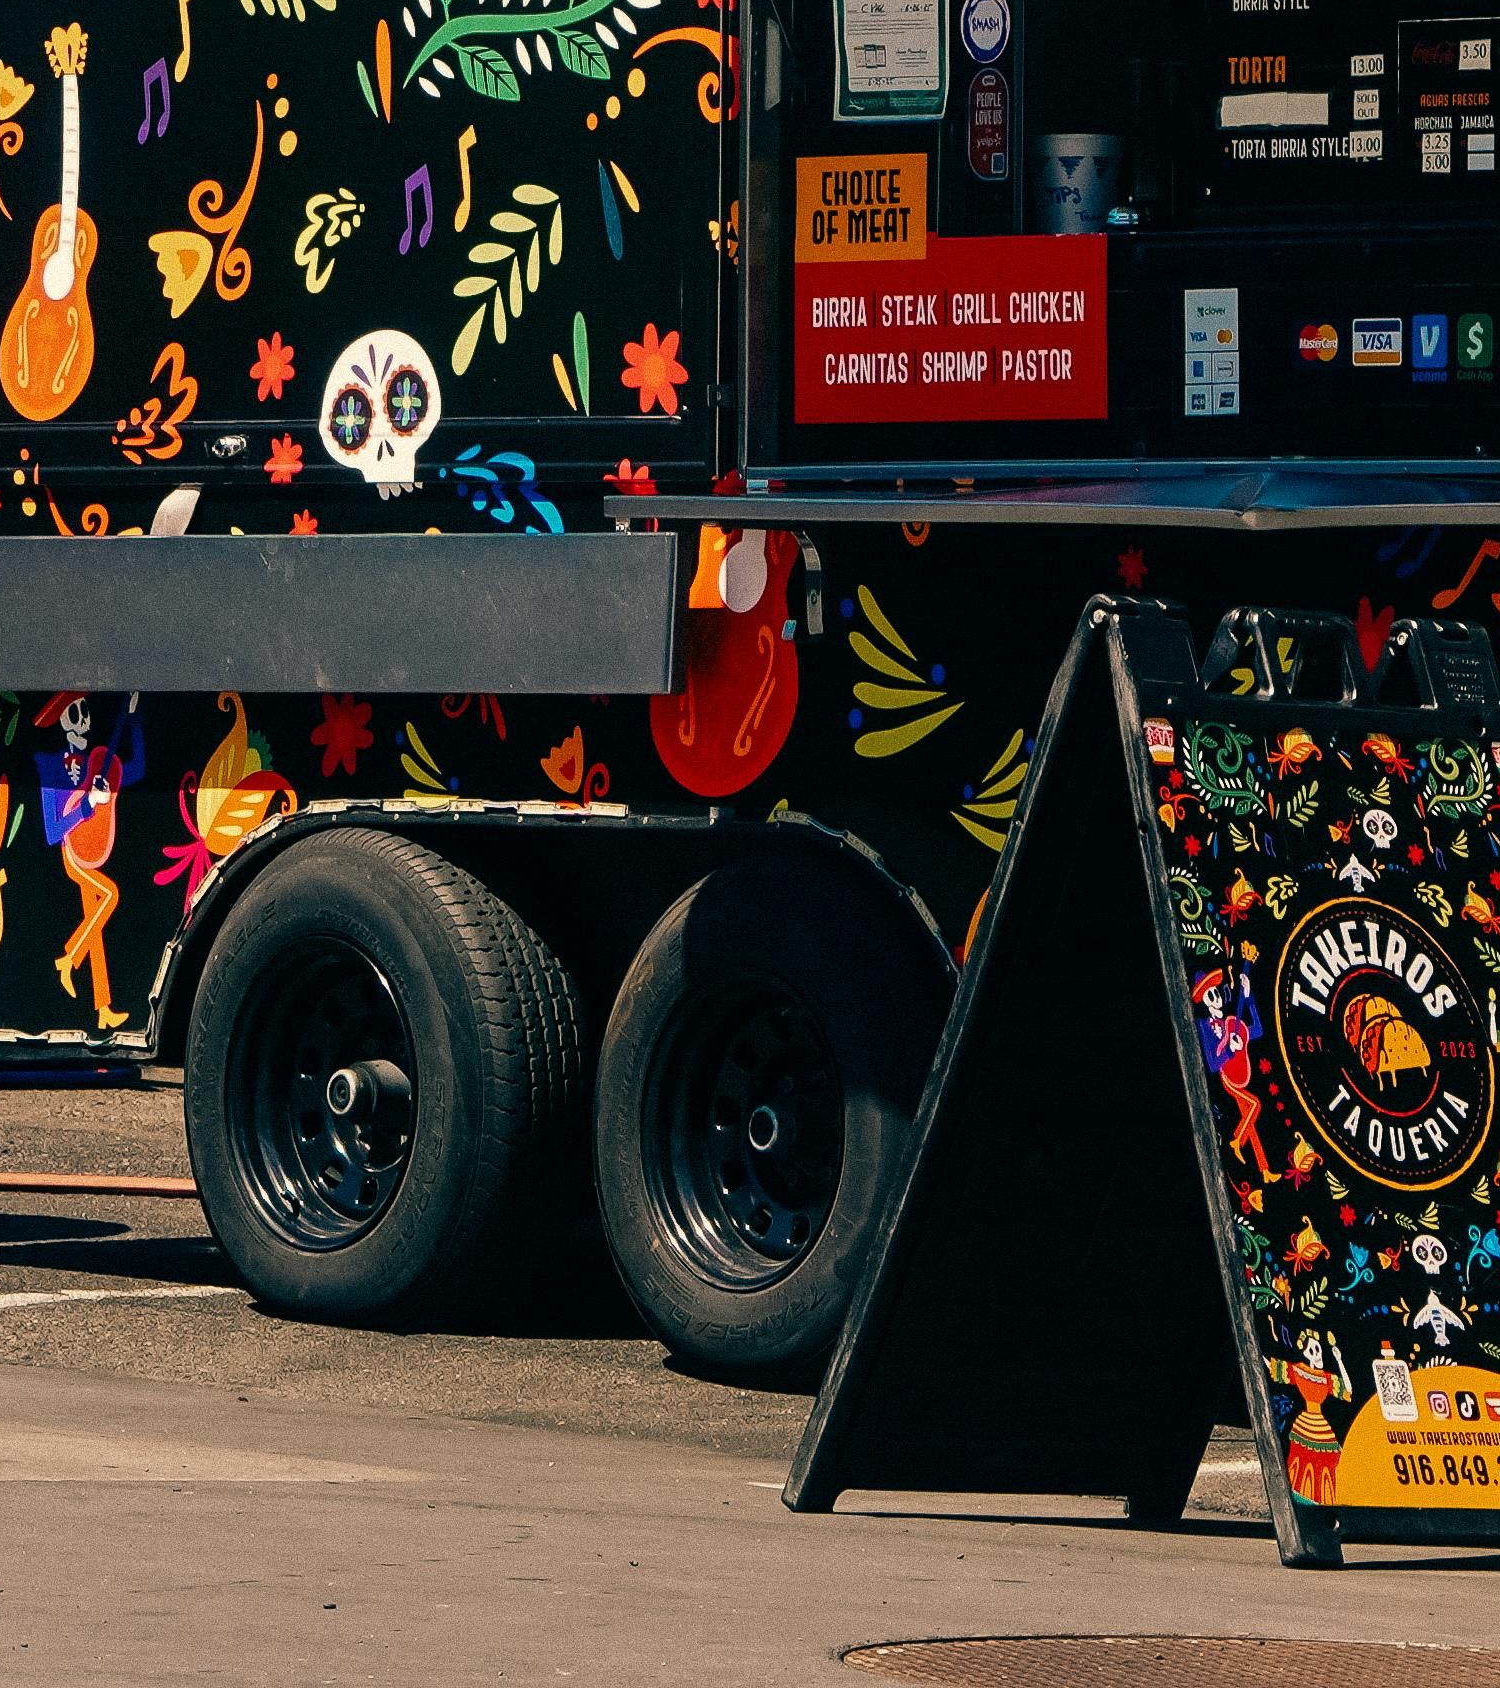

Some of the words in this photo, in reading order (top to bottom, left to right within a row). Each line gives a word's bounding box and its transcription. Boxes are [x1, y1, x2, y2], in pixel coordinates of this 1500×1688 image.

[972, 18, 1000, 31] SMASH
[1462, 44, 1486, 59] 3.50
[1229, 55, 1286, 85] TORTA
[1354, 58, 1382, 74] 13.00
[977, 92, 1001, 107] PEOPLE
[1356, 93, 1377, 104] SOLD
[1420, 94, 1450, 106] AGUAS
[1452, 93, 1489, 106] FRESCAS
[976, 110, 992, 125] LOVE
[1358, 108, 1375, 118] OUT
[1415, 116, 1453, 131] HORCHATA
[1461, 115, 1495, 130] JAMAICA
[1231, 139, 1266, 160] TORTA
[1271, 138, 1308, 158] BIRRIA
[1312, 136, 1349, 157] STYLE
[1424, 135, 1448, 150] 3.25
[1425, 155, 1448, 171] 5.00
[821, 168, 901, 207] CHOICE
[812, 210, 839, 246] OF
[848, 208, 910, 243] MEAT
[812, 296, 867, 328] BIRRIA
[881, 294, 937, 326] STEAK
[952, 293, 1001, 325] GRILL
[1009, 290, 1084, 323] CHICKEN
[1205, 306, 1225, 315] clover
[1190, 332, 1207, 342] VISA
[1299, 338, 1338, 350] MasterCard
[1361, 333, 1393, 350] VISA
[825, 354, 908, 385] CARNITAS
[922, 351, 987, 383] SHRIMP
[1002, 349, 1072, 381] PASTOR
[1291, 920, 1457, 1019] TAKEIROS
[1298, 1034, 1330, 1055] EST.
[1440, 1039, 1477, 1059] 2023
[1329, 1084, 1471, 1163] TAQUERIA
